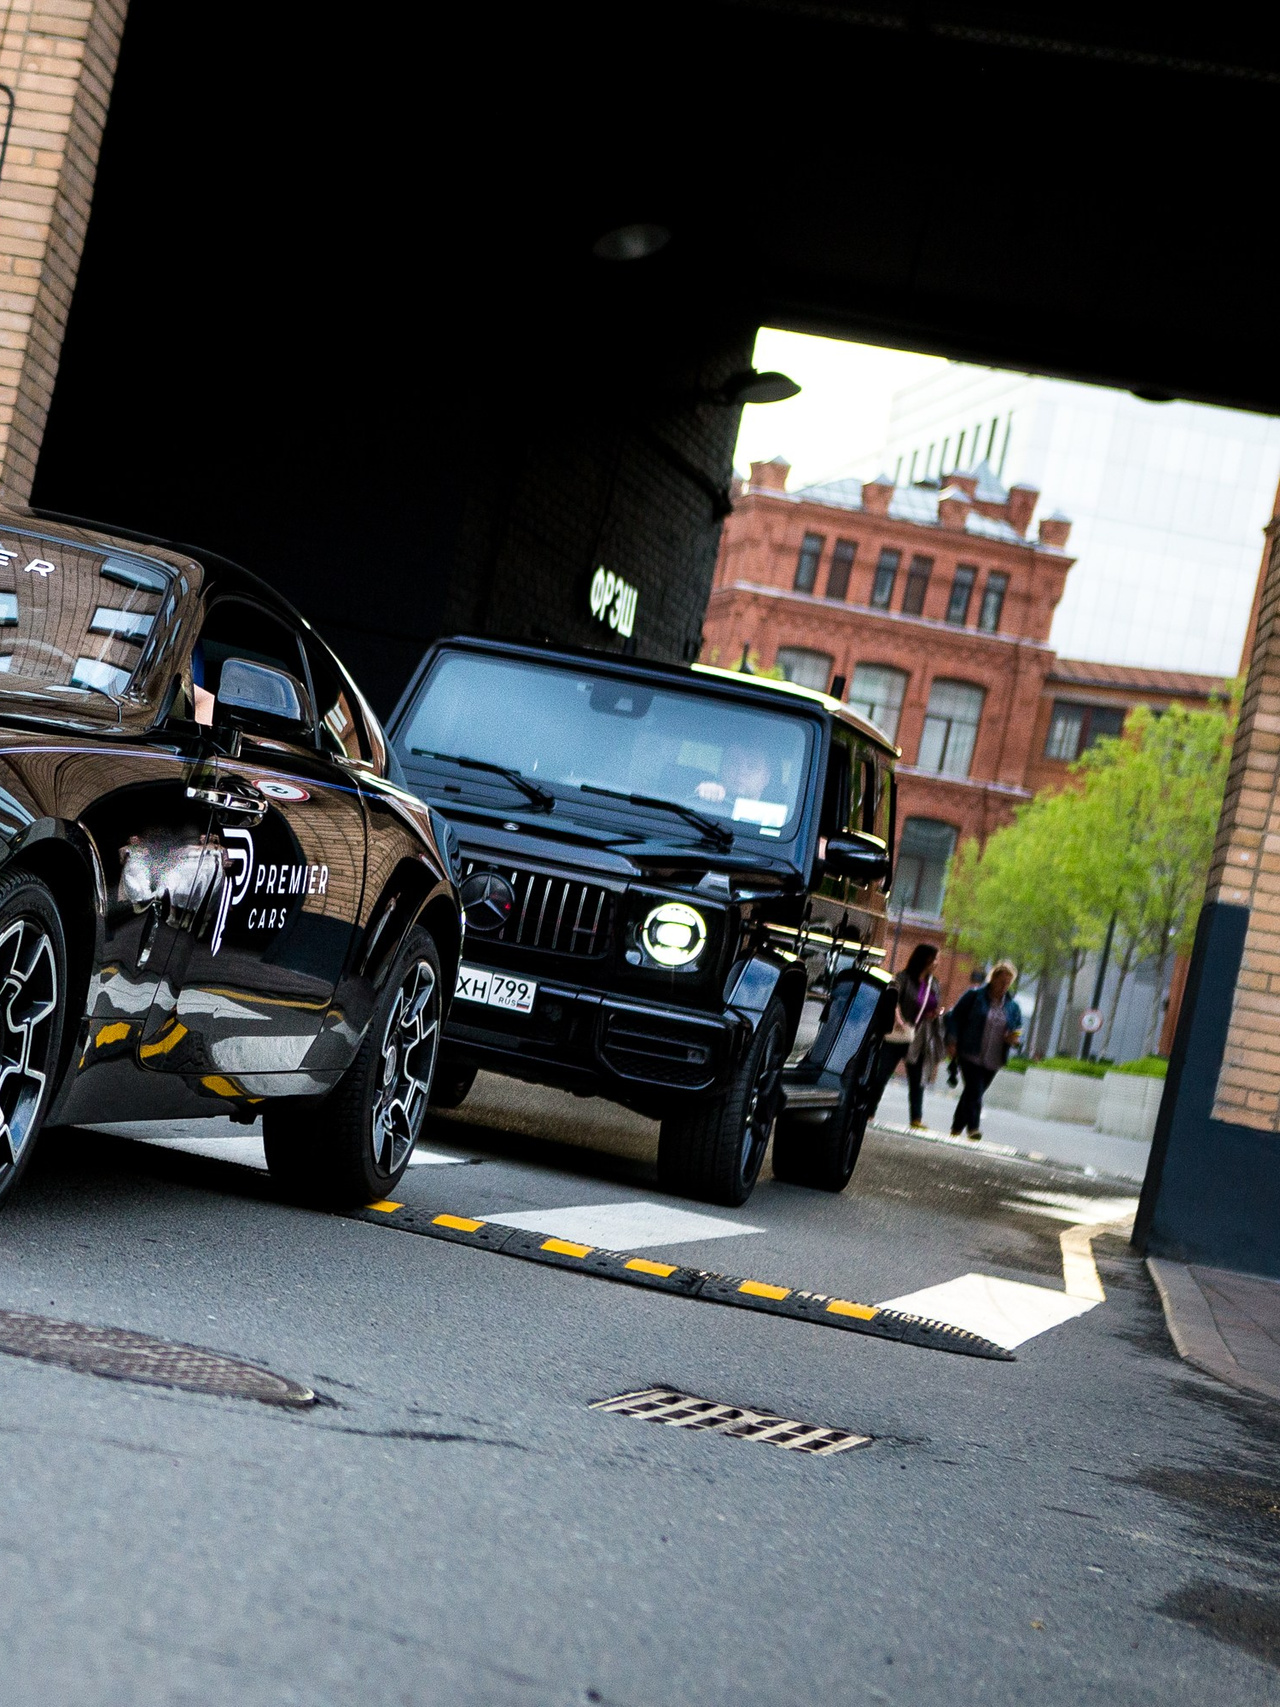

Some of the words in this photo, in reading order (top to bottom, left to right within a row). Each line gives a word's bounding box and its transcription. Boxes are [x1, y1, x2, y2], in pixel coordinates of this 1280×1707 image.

[590, 565, 638, 638] ФРЭШ
[254, 864, 329, 895] PREMIER
[247, 907, 288, 930] CARS
[493, 976, 529, 1001] 799
[498, 996, 517, 1007] RUS
